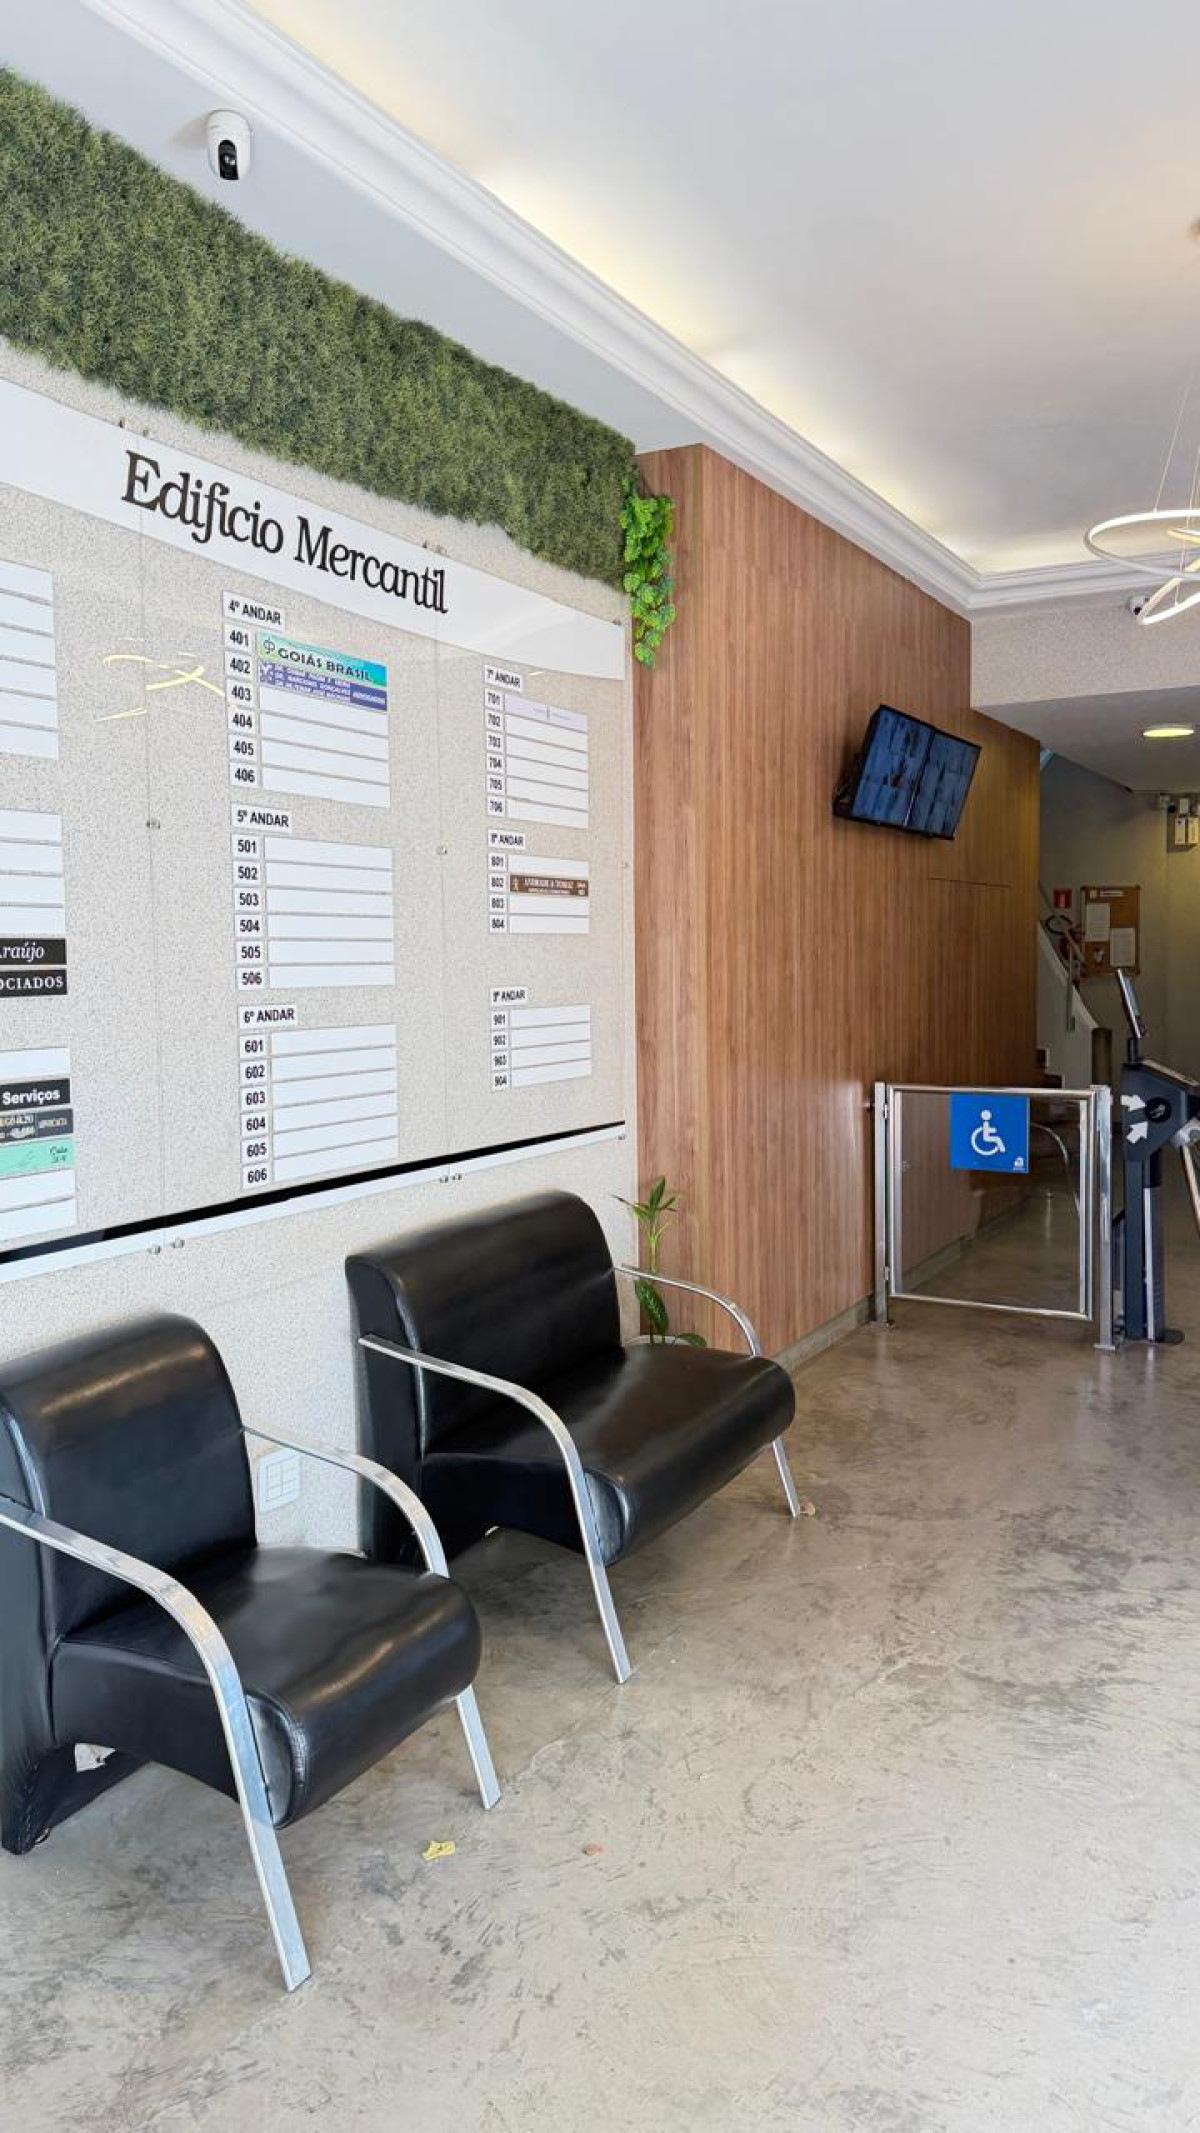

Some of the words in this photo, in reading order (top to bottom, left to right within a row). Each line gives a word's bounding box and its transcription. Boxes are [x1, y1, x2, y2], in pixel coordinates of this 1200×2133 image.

[293, 515, 448, 613] Mercantil
[242, 604, 281, 625] ANDAR
[229, 629, 249, 647] 401
[277, 647, 322, 668] GOIÁS
[229, 657, 250, 674] 402
[495, 672, 521, 688] ANDAR
[231, 684, 251, 701] 403
[487, 692, 500, 705] 701
[232, 712, 252, 728] 404
[488, 713, 501, 727] 702
[233, 740, 254, 757] 405
[488, 735, 501, 748] 703
[489, 757, 502, 769] 704
[234, 768, 255, 783] 406
[489, 778, 502, 790] 705
[489, 800, 503, 812] 706
[250, 812, 289, 827] ANDAR
[237, 840, 257, 853] 501
[499, 835, 524, 846] ANDAR
[237, 866, 258, 880] 502
[239, 893, 259, 906] 503
[239, 919, 260, 932] 504
[241, 946, 261, 959] 505
[242, 972, 262, 986] 506
[501, 989, 525, 1000] ANDAR
[256, 1008, 294, 1022] ANDAR
[244, 1039, 264, 1053] 601
[245, 1065, 265, 1079] 602
[2, 1088, 61, 1106] Serviços
[245, 1091, 265, 1105] 603
[246, 1117, 266, 1131] 604
[246, 1143, 267, 1157] 605
[247, 1168, 267, 1183] 606
